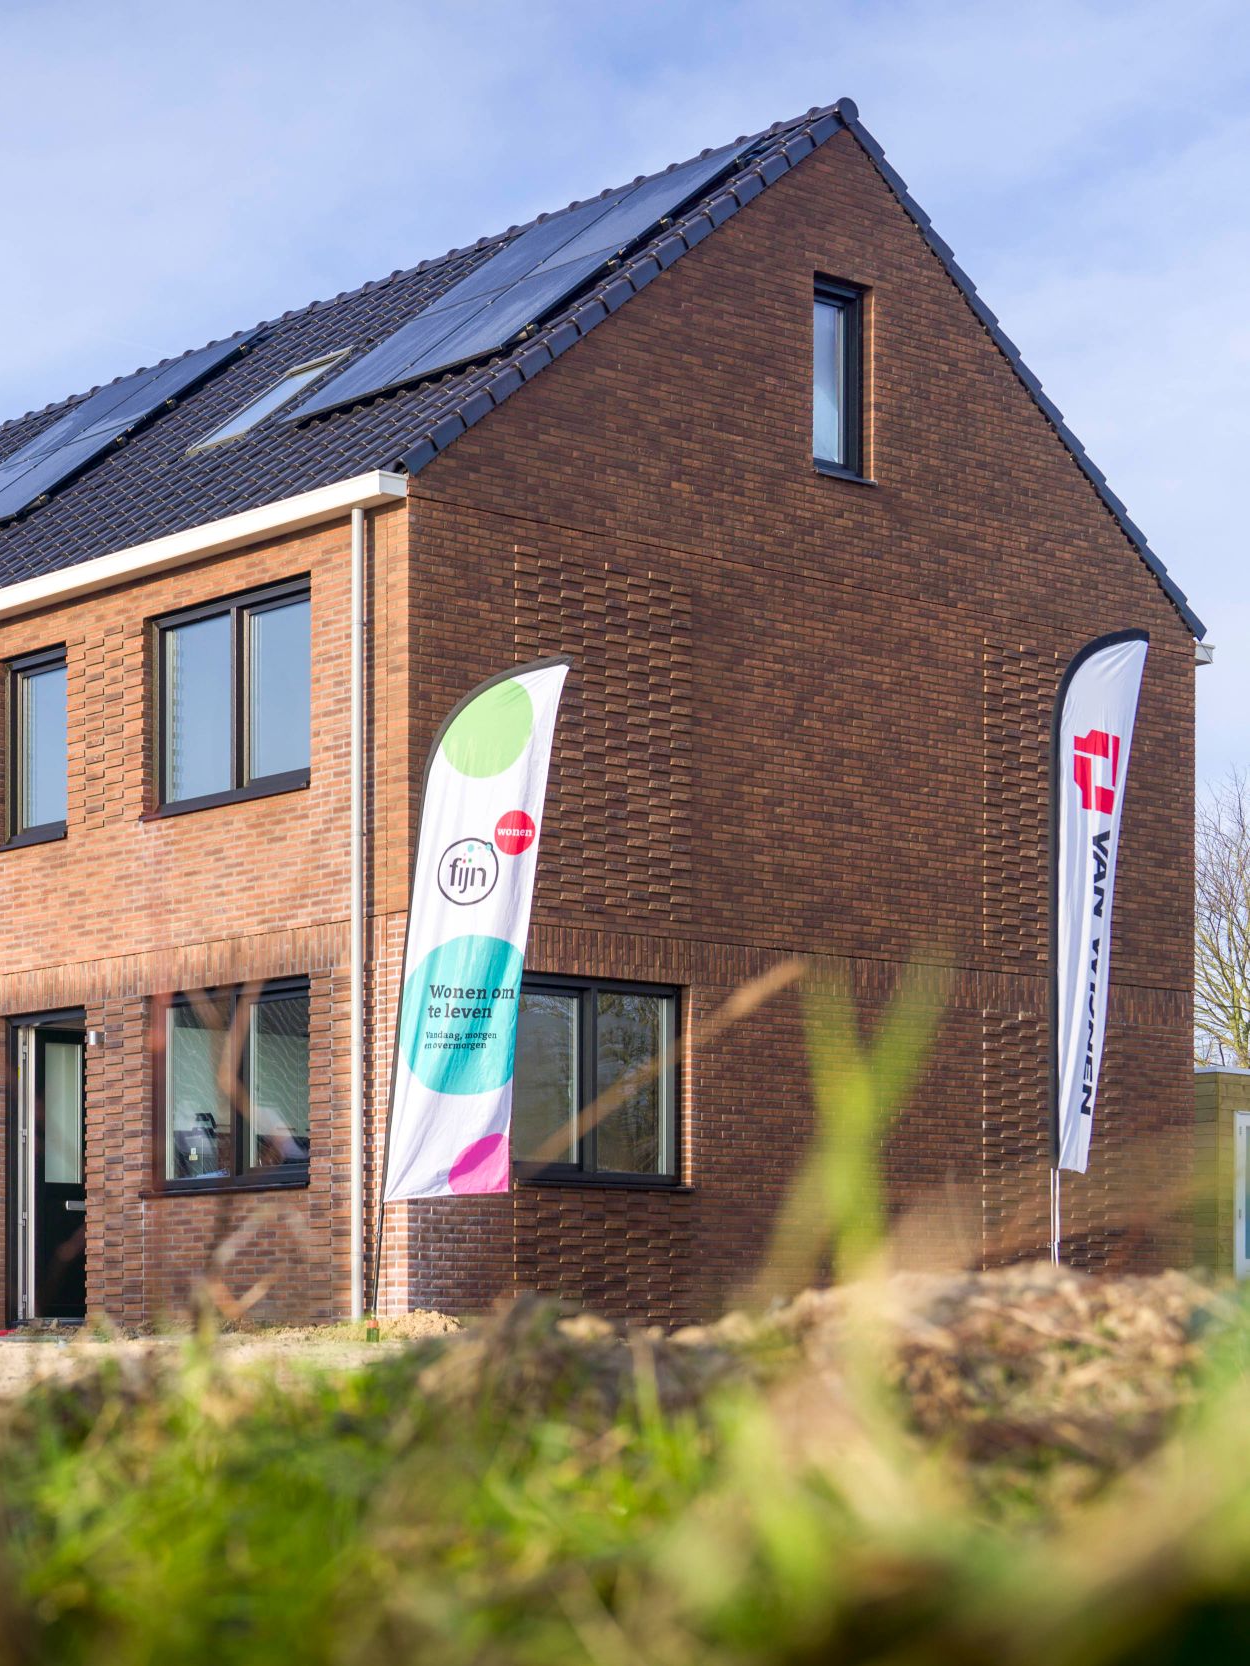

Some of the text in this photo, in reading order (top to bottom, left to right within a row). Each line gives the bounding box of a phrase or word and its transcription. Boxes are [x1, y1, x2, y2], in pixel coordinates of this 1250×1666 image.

[497, 828, 533, 837] wonen
[449, 857, 487, 894] fijn
[1092, 830, 1111, 919] VAN
[429, 984, 515, 1000] Wonen om
[428, 1003, 493, 1019] te leven
[425, 1031, 497, 1041] Vandaag, morgen
